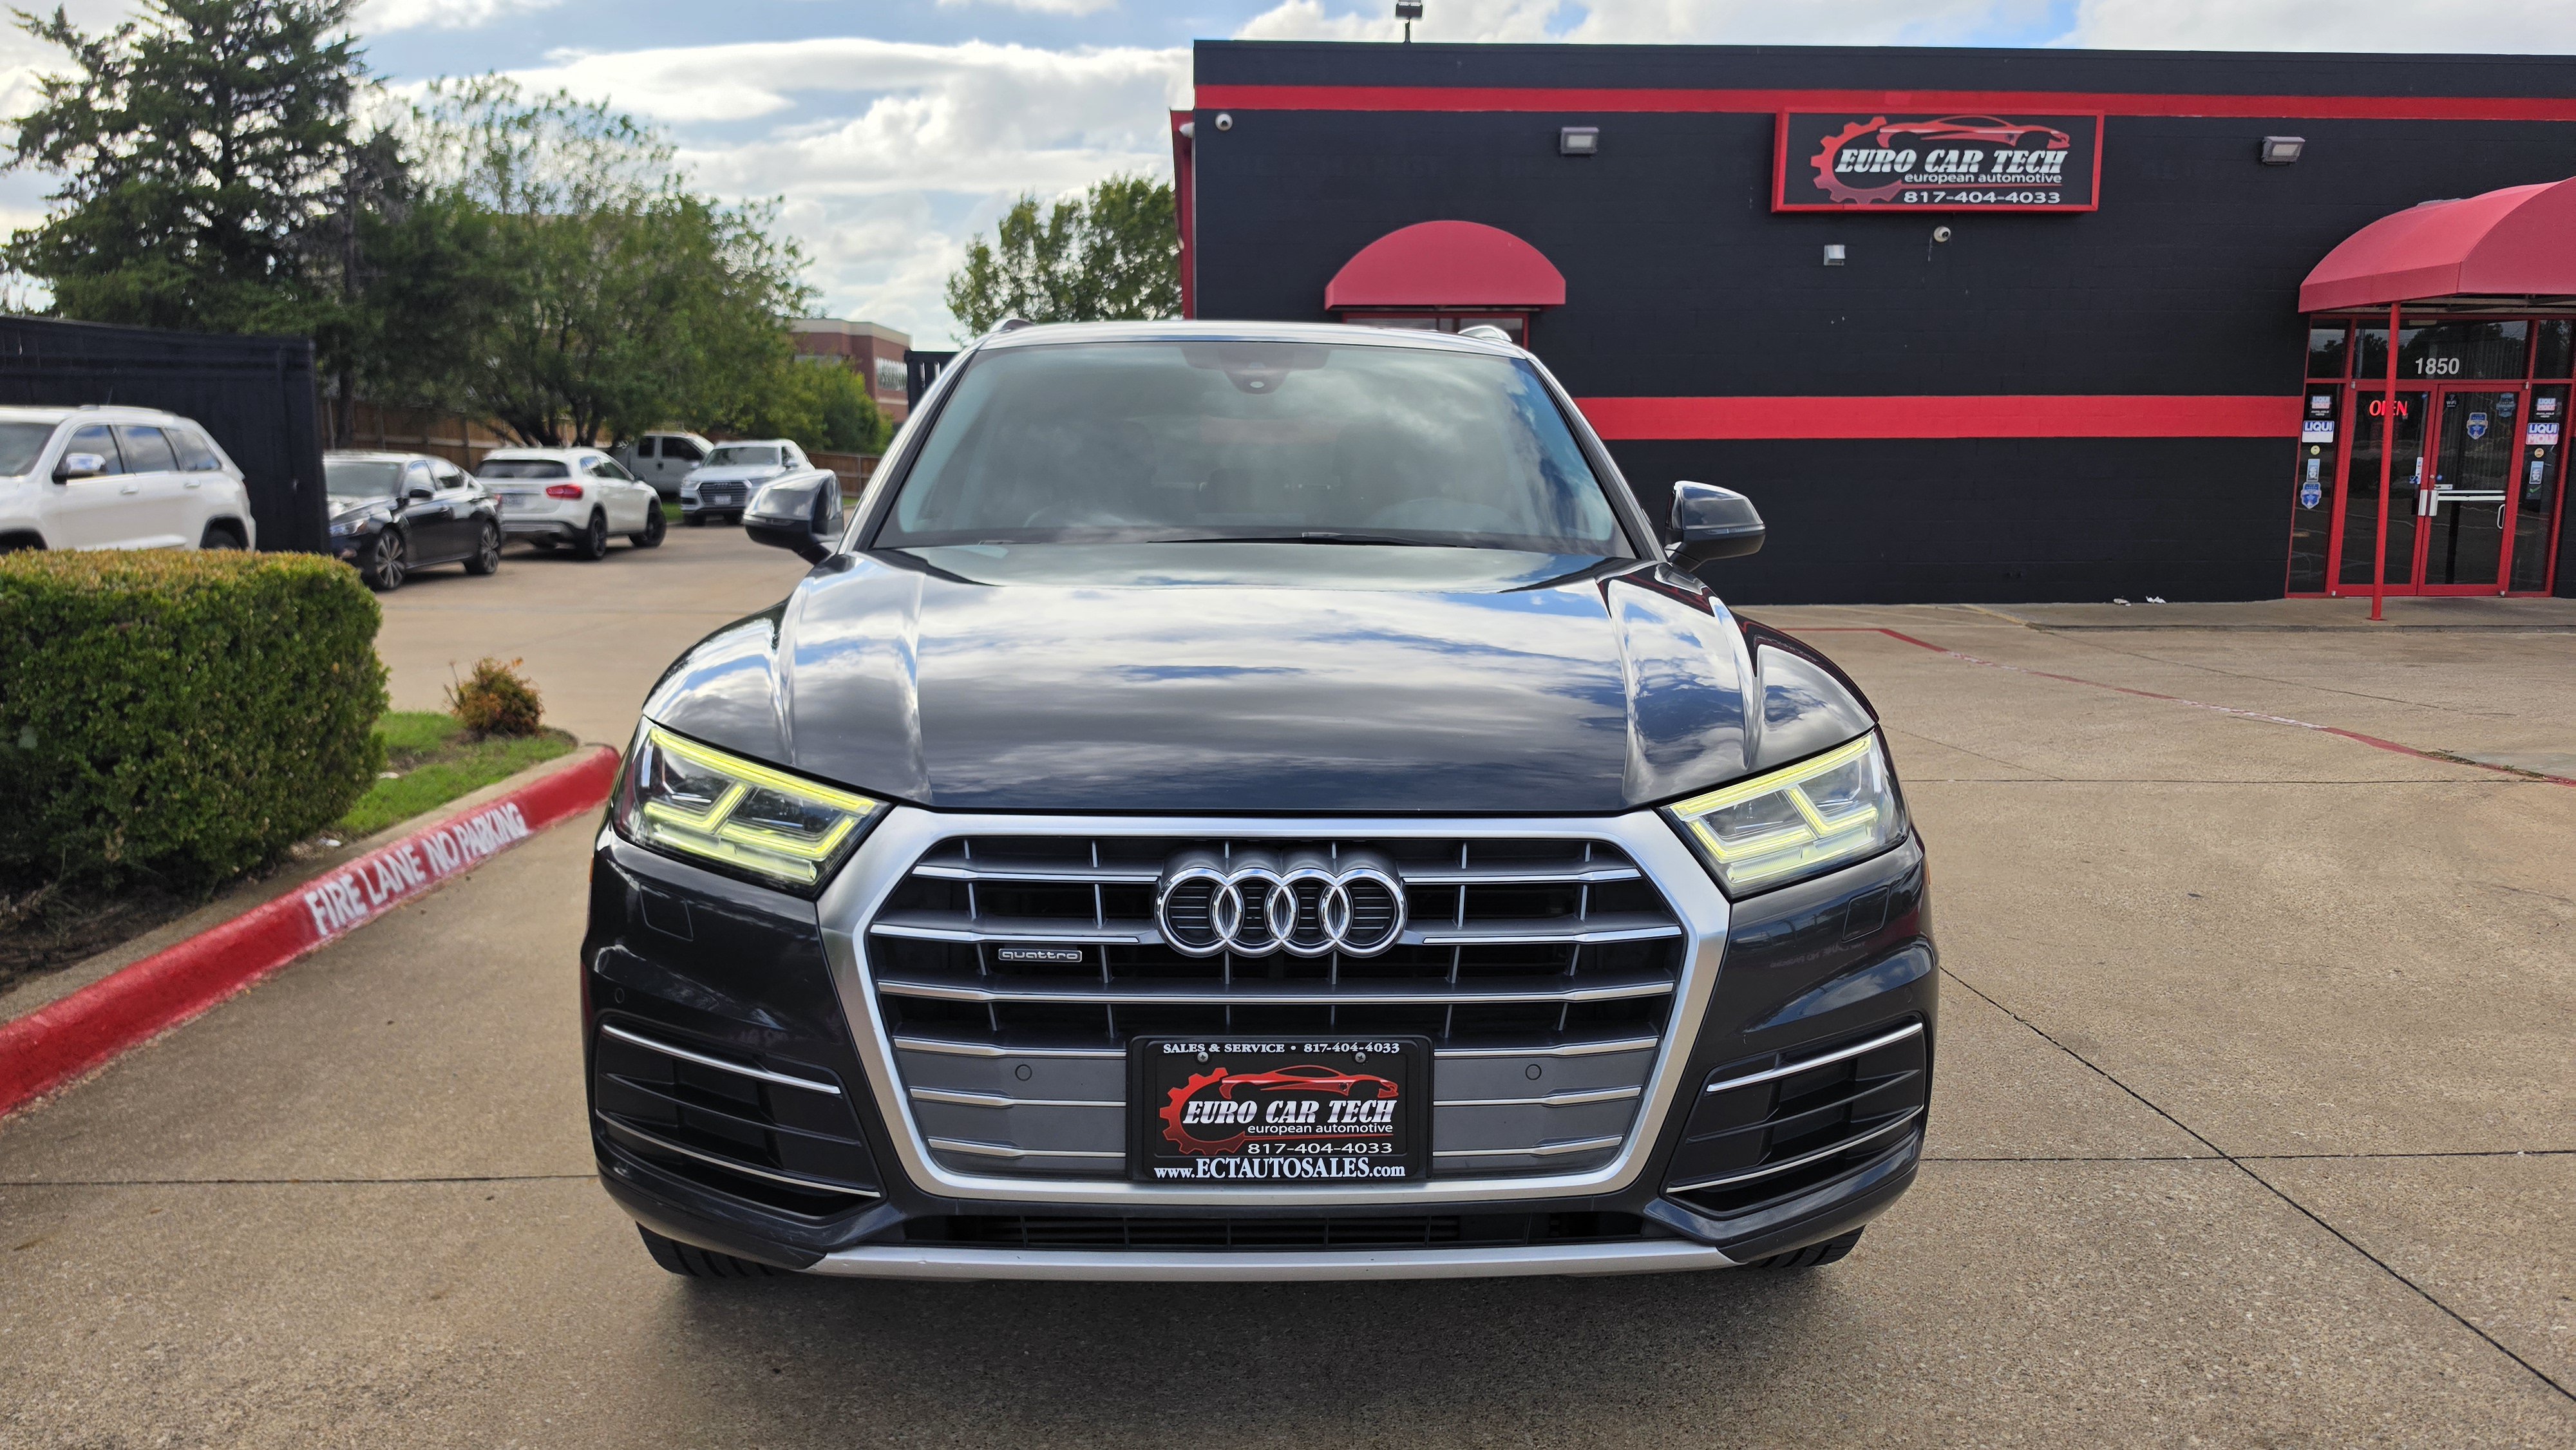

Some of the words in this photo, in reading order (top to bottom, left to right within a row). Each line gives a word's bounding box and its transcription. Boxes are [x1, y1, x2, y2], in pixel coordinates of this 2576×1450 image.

[1835, 149, 1917, 173] EURO
[1925, 149, 1984, 173] CAR
[1993, 150, 2068, 173] TECH
[1904, 173, 1975, 184] european
[1978, 173, 2062, 184] automotive
[1904, 191, 2061, 204] 817-404-4033
[2415, 357, 2460, 375] 1850
[2304, 422, 2333, 433] LIQUI
[2529, 424, 2557, 435] LIQUI
[2528, 434, 2557, 444] MOLY
[305, 874, 366, 936] FIRE
[358, 845, 425, 905] LANE
[422, 831, 459, 876] NO
[453, 802, 529, 862] PARKING
[1002, 951, 1077, 959] quattro
[1163, 1043, 1206, 1053] SALES
[1209, 1043, 1220, 1053] &
[1224, 1043, 1285, 1053] SERVICE
[1303, 1042, 1400, 1053] 817-404-4033
[1183, 1100, 1258, 1124] EURO
[1265, 1100, 1320, 1124] CAR
[1328, 1100, 1397, 1123] TECH
[1247, 1125, 1312, 1136] european
[1316, 1123, 1393, 1133] automotive
[1247, 1142, 1392, 1154] 817-404-4033
[1154, 1157, 1406, 1179] www.ECTAUTOSALES.com
